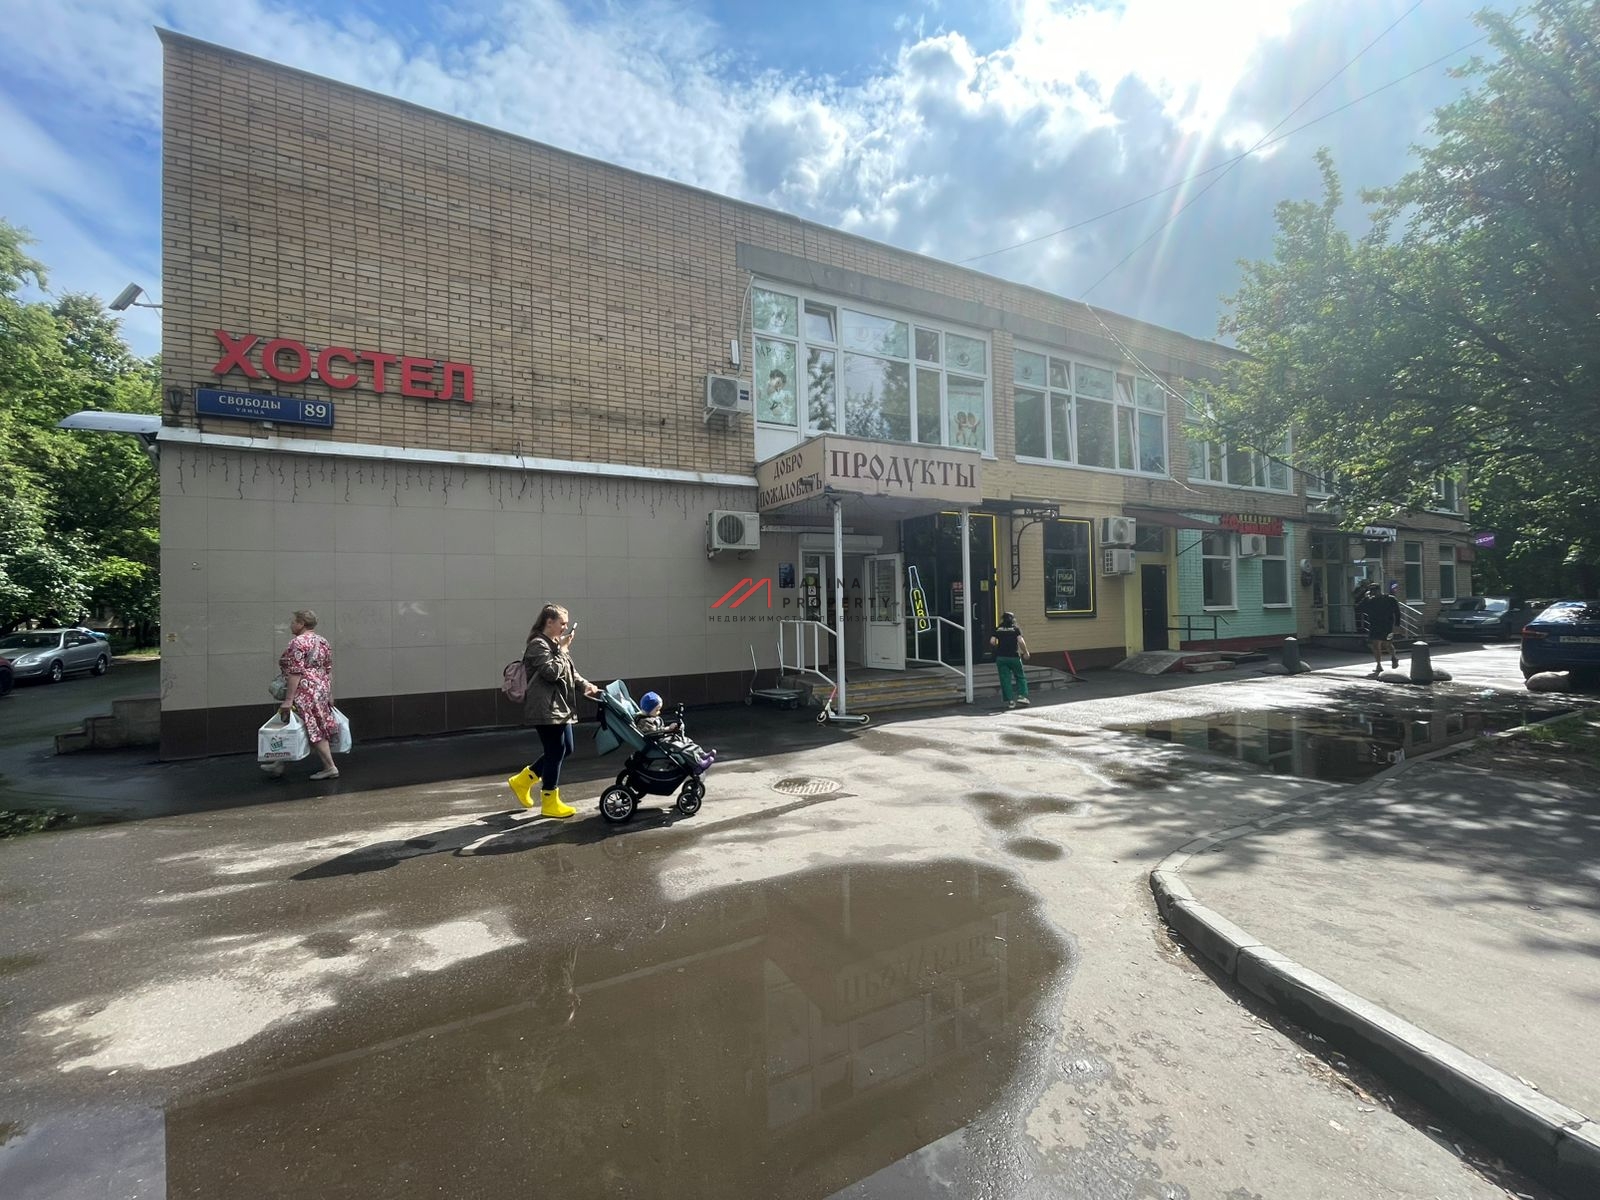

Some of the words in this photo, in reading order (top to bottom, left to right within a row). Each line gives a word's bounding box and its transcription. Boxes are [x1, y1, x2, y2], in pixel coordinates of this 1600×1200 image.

[211, 329, 475, 403] ХОСТЕЛ
[218, 395, 281, 410] СВОБОДЫ
[235, 407, 265, 415] УЛИЦА
[304, 403, 327, 418] 89
[773, 452, 803, 480] ДОБРО
[829, 449, 977, 491] ПРОДУКТЫ
[913, 589, 927, 629] ПИВО
